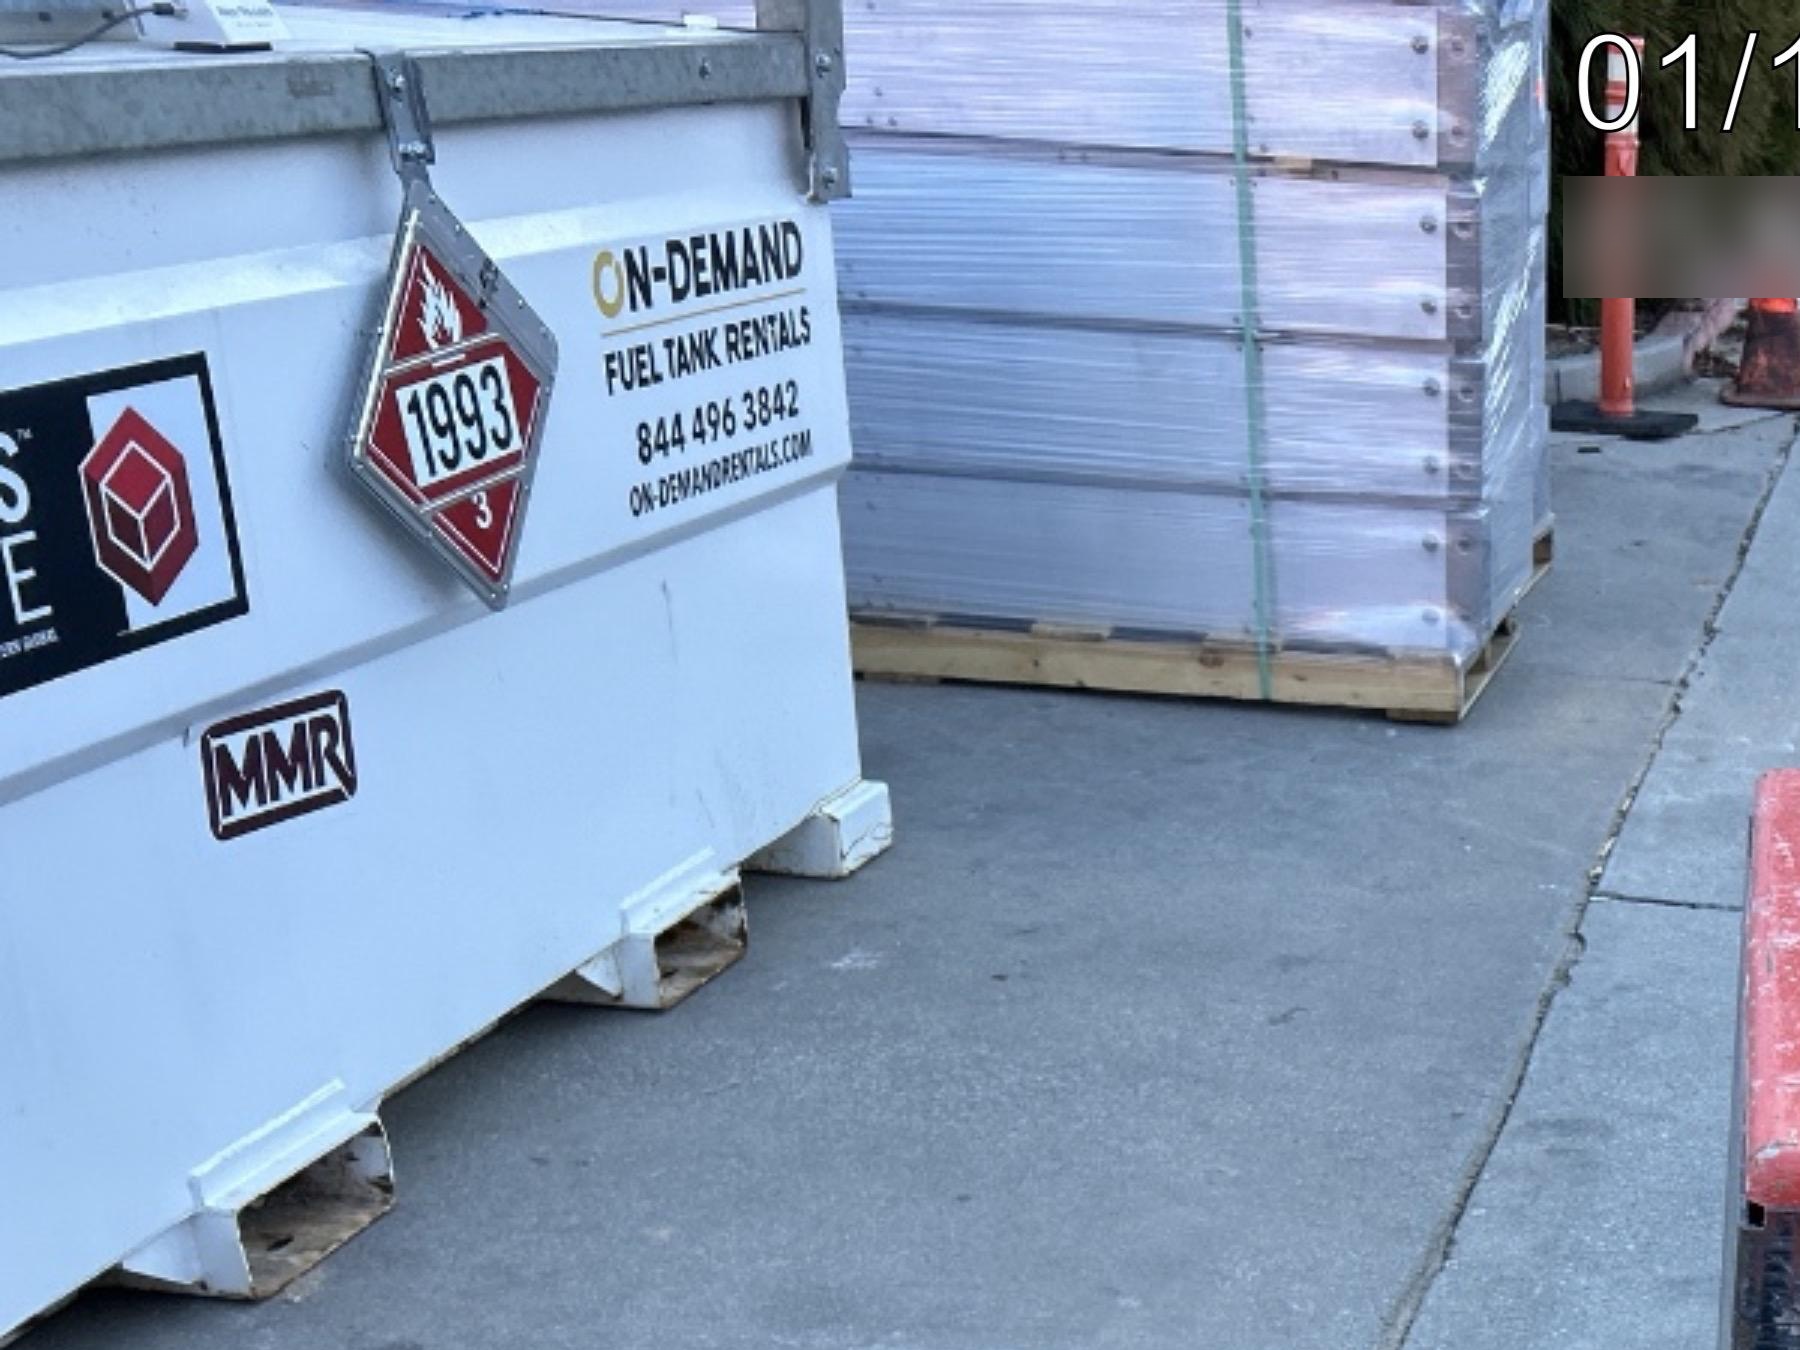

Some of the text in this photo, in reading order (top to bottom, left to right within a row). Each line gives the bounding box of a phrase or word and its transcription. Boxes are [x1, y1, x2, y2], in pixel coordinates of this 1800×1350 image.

[593, 220, 803, 319] ON-DEMAND
[604, 306, 812, 396] FUEL TANK RENTALS
[407, 365, 513, 477] 1993
[637, 379, 799, 466] 844 496 3842
[472, 491, 492, 529] 3
[629, 428, 813, 517] ON-DEMANDRENTALS.COM
[213, 714, 354, 817] MMR
